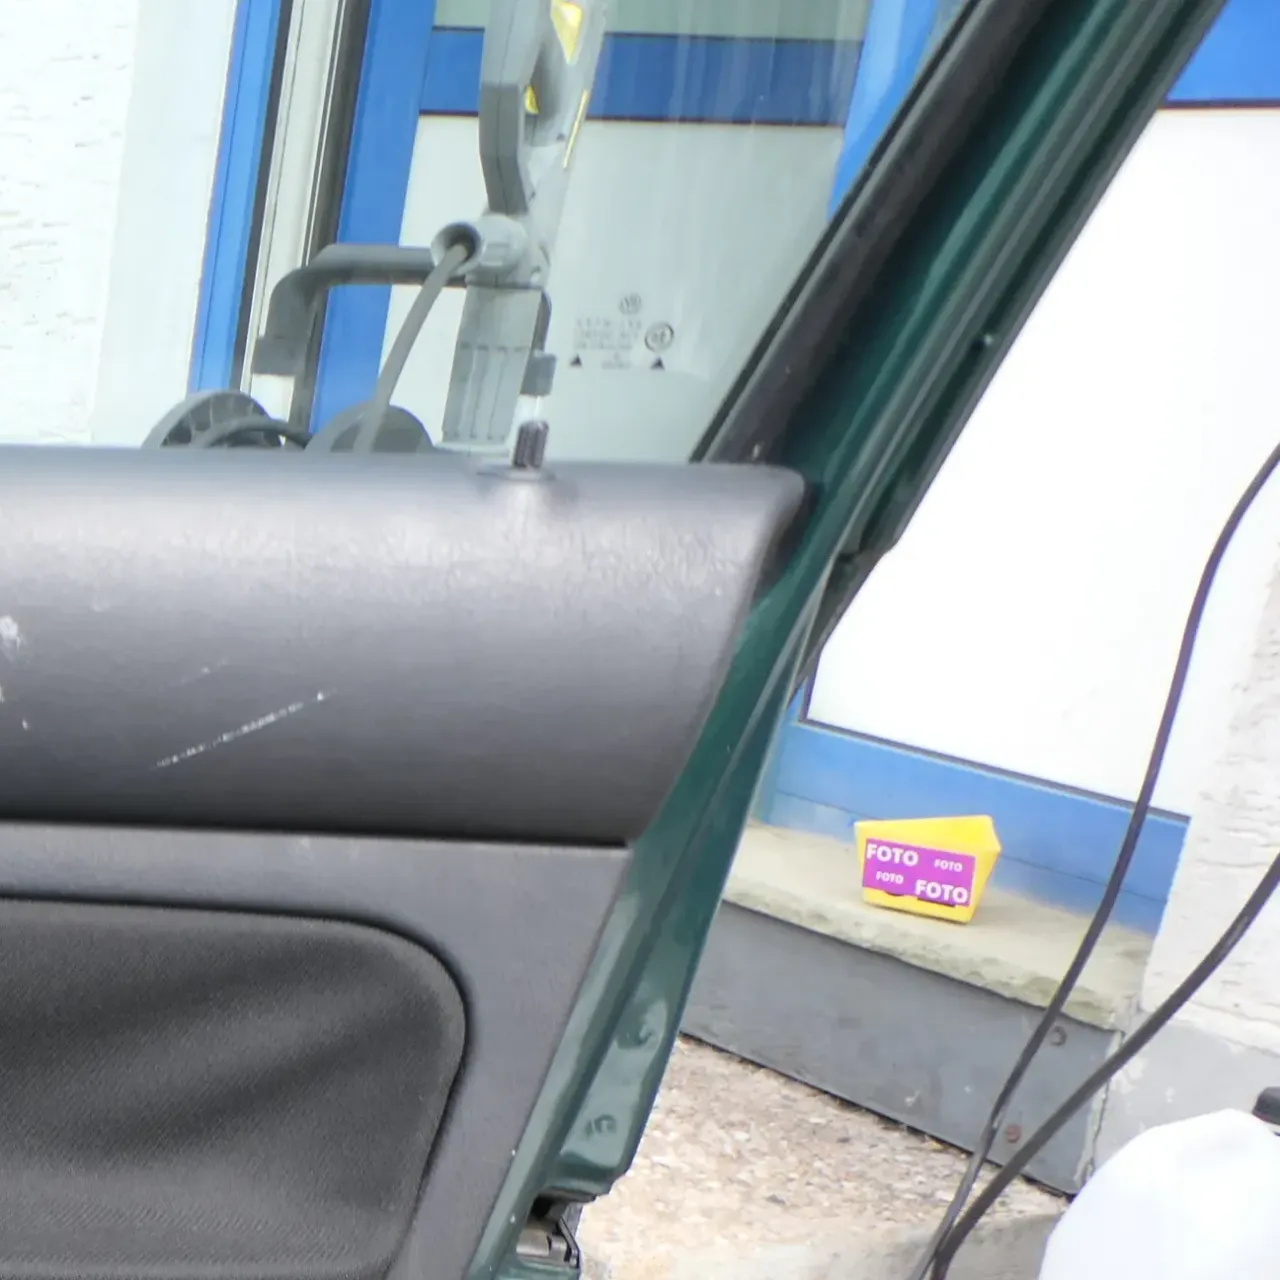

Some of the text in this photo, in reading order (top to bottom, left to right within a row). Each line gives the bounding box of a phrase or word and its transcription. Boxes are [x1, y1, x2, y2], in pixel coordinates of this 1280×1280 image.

[866, 843, 963, 873] FOTO FOTO
[875, 871, 968, 904] FOTO FOTO
